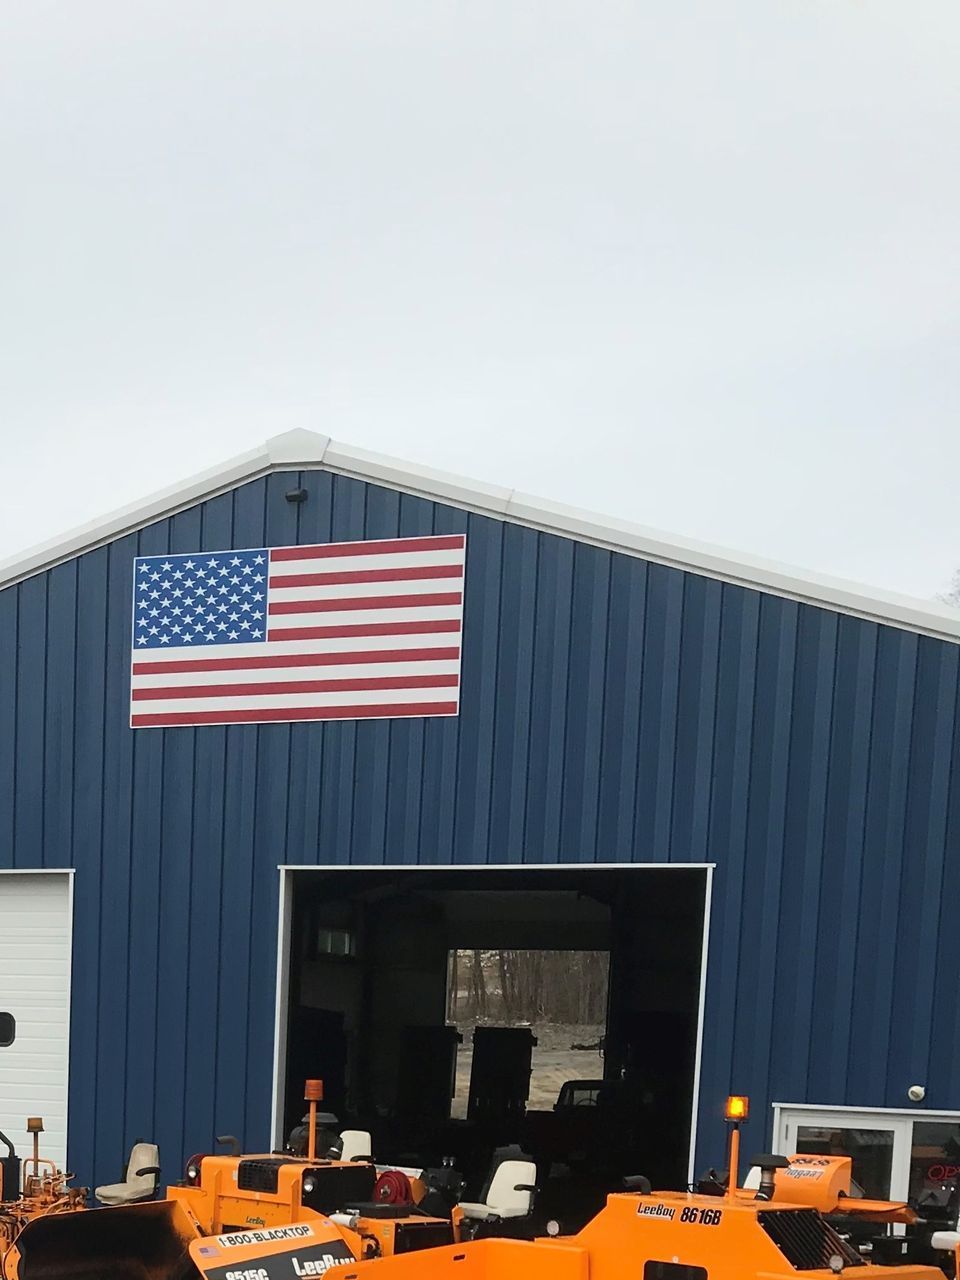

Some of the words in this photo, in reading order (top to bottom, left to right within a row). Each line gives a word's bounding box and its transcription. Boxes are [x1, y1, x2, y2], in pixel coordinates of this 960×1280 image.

[637, 1202, 676, 1220] LeeBoy
[680, 1206, 722, 1226] 8616B
[219, 1226, 310, 1247] 1-800-BLACKTOP
